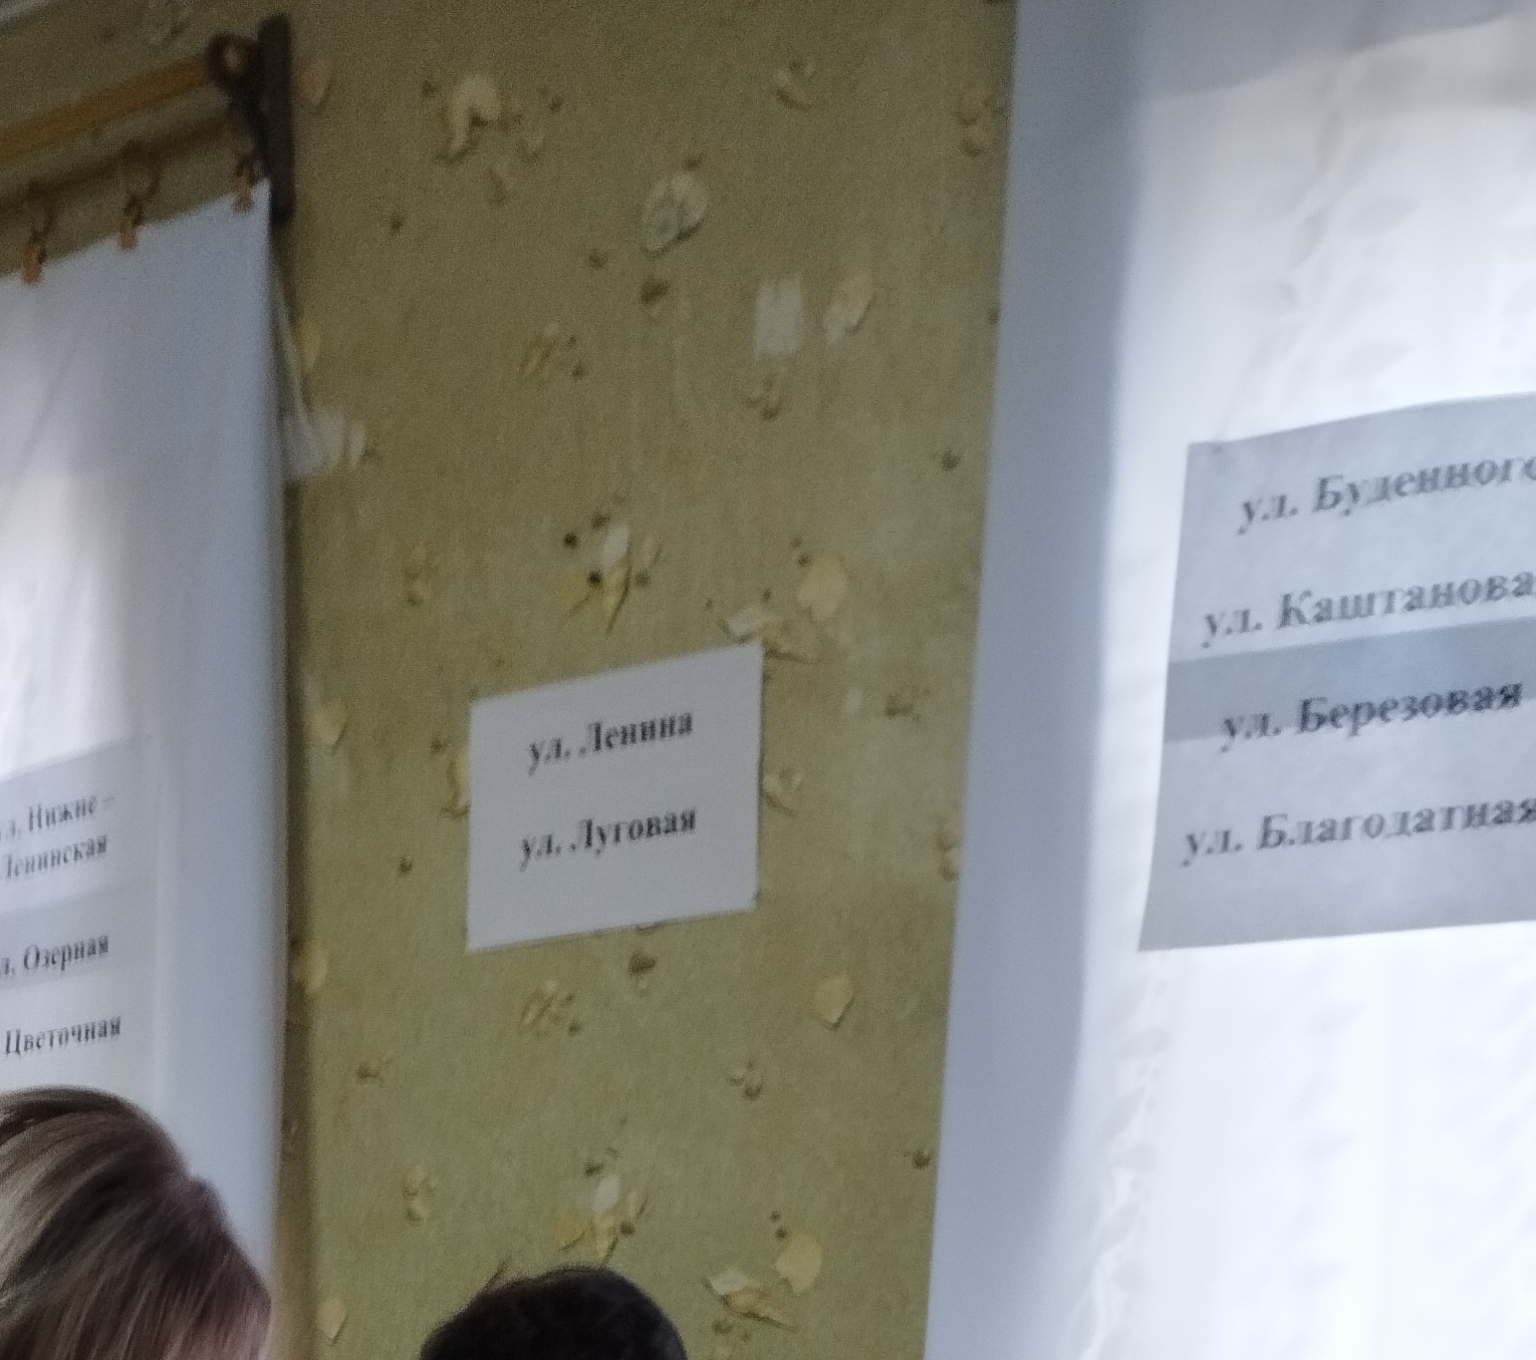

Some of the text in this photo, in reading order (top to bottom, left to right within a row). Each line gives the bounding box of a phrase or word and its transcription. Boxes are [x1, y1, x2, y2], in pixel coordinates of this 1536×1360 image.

[1237, 492, 1299, 535] ул.
[1201, 570, 1536, 649] ул. Каштанова
[528, 711, 694, 776] ул. Ленина
[1219, 681, 1524, 753] ул. Березовая
[518, 807, 697, 872] ул. Луговая
[1180, 797, 1536, 868] ул. Благодатная
[22, 934, 110, 973] Озерная
[4, 1016, 122, 1060] Цветочная
